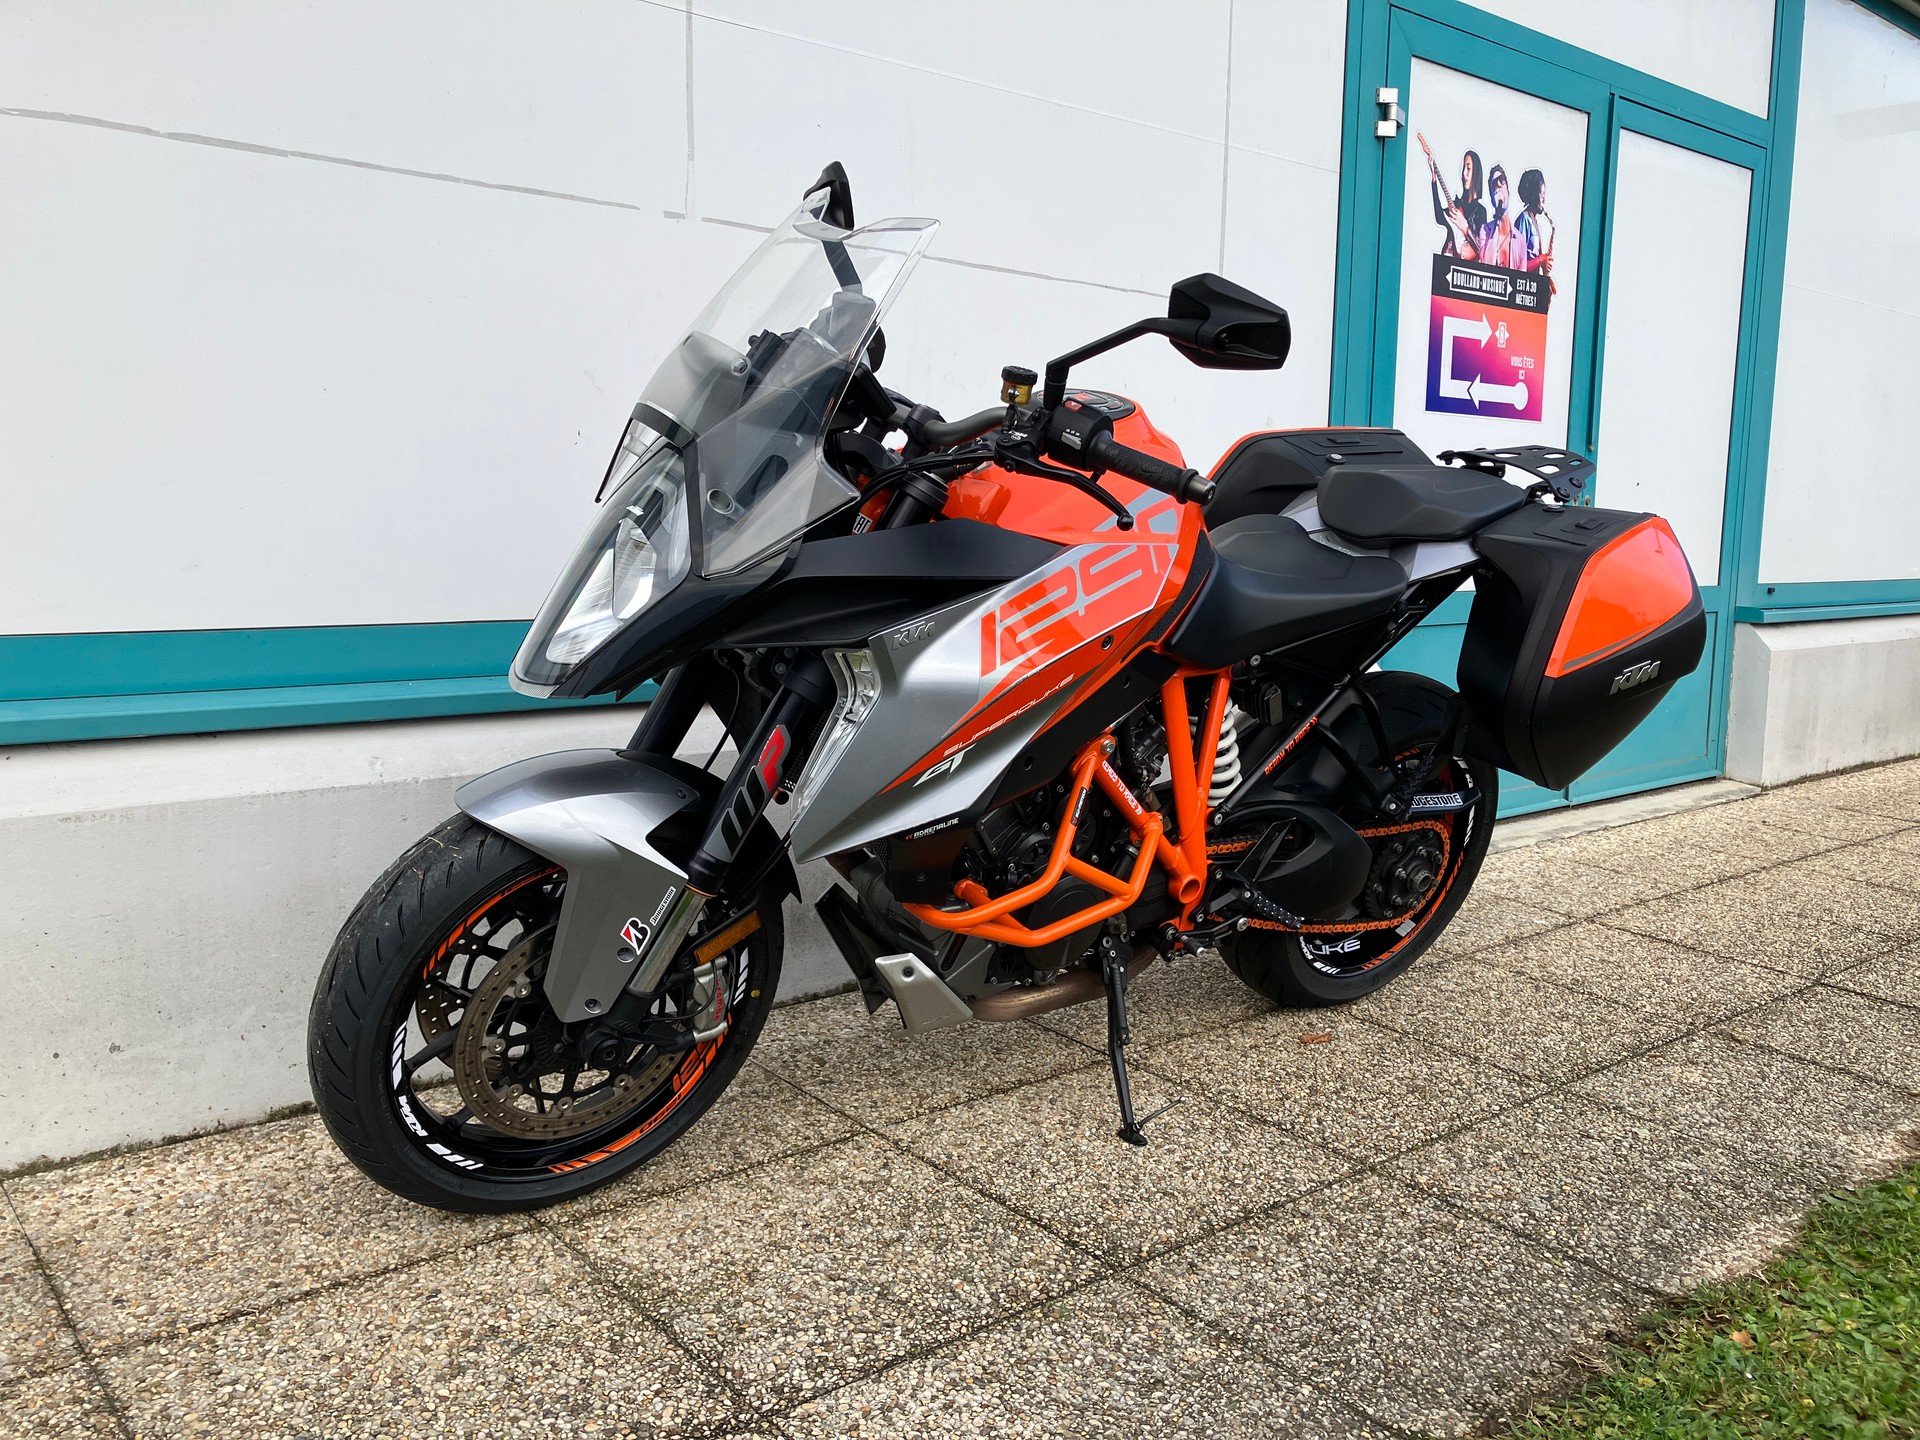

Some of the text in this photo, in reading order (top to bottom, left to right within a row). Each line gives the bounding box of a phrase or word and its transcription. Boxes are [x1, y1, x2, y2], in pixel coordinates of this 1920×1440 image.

[1516, 279, 1526, 290] EST
[1510, 355, 1535, 369] VOUS ÊTES
[891, 620, 936, 651] KTM
[1609, 660, 1661, 695] KTM
[1264, 722, 1311, 776] READY TO RACE
[1116, 778, 1126, 793] TO
[1123, 788, 1137, 809] RACE
[914, 817, 960, 838] ADRENALINE
[398, 1095, 429, 1137] KTM
